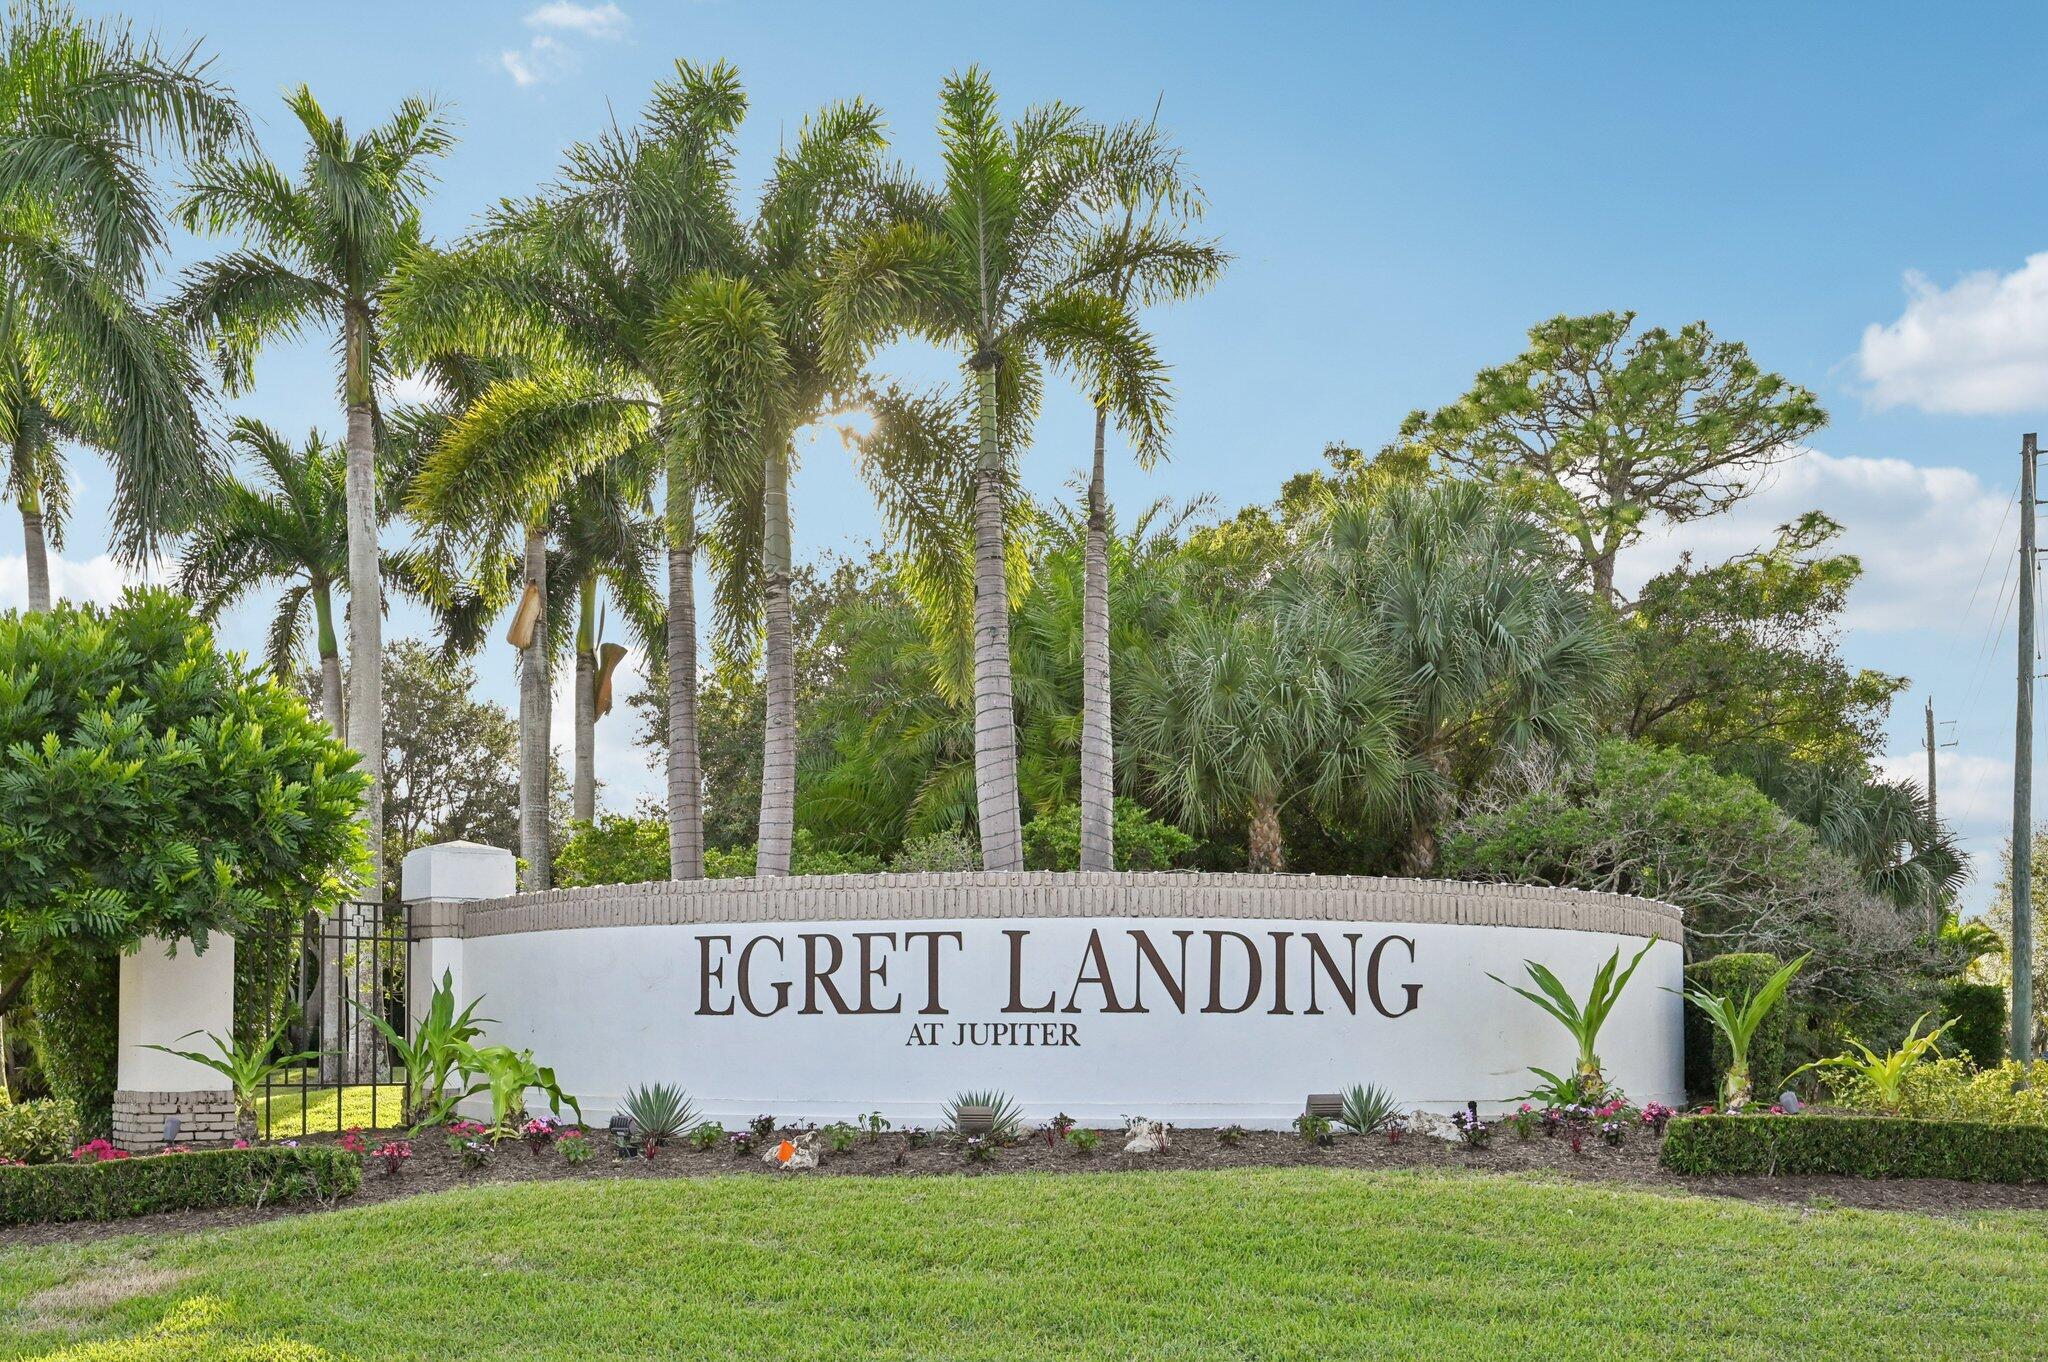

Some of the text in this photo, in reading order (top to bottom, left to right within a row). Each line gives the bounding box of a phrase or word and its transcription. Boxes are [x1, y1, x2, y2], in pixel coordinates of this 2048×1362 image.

[694, 928, 1424, 1019] EGRET LANDING
[905, 1022, 1081, 1047] AT JUPITER
